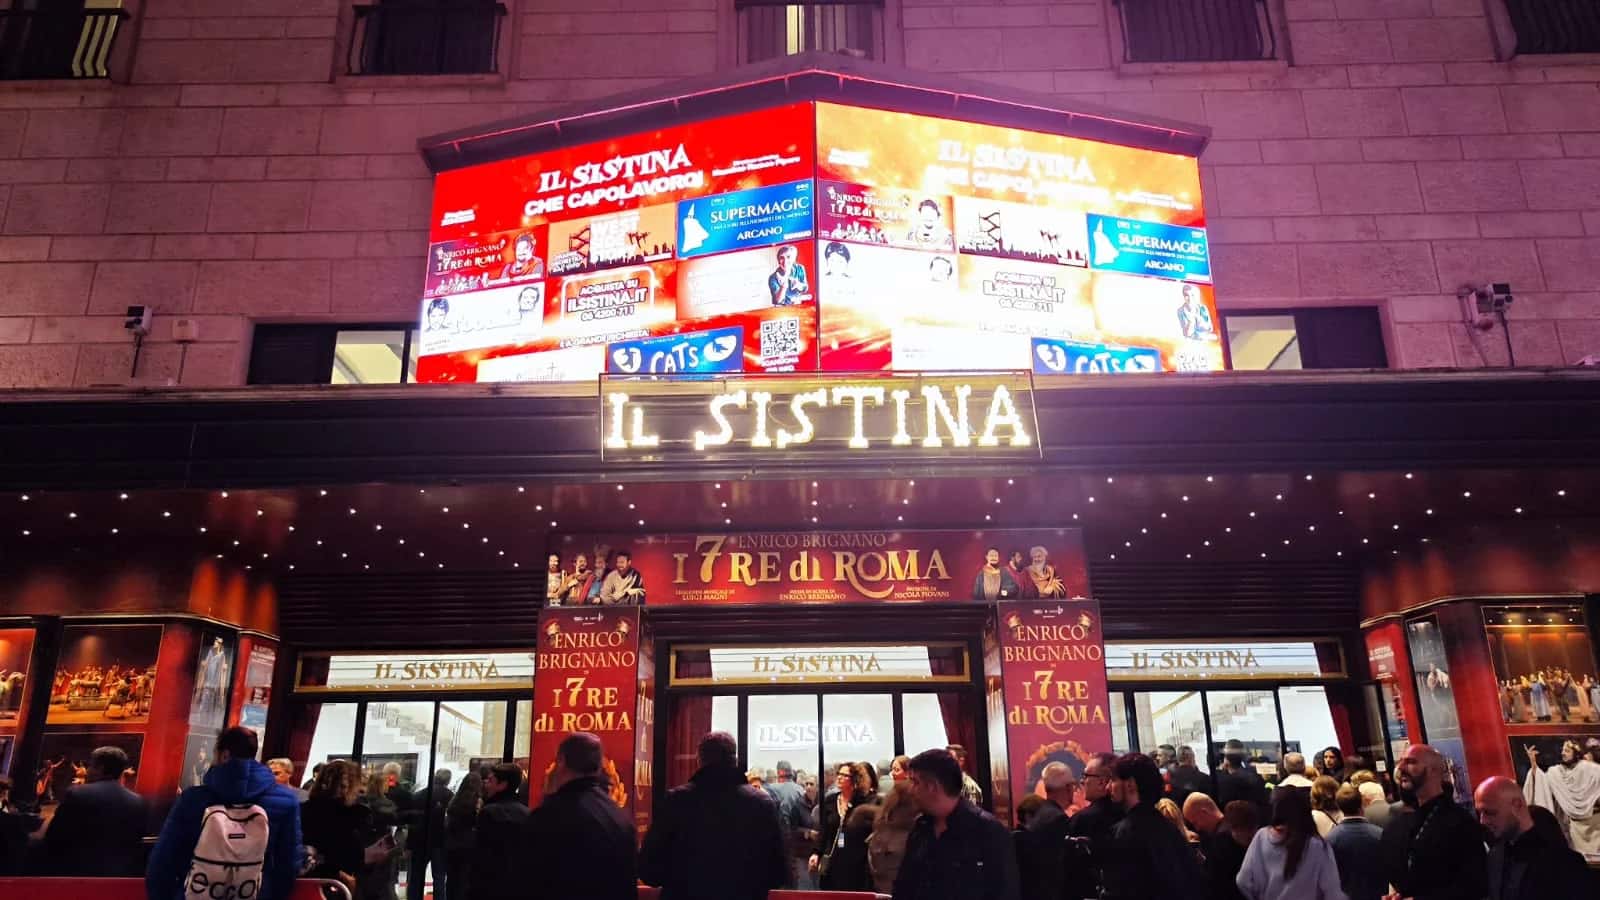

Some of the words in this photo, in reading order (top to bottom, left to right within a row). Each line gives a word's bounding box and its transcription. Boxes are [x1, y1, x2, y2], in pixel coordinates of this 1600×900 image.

[537, 170, 567, 193] IL
[570, 143, 692, 190] SISTINA
[525, 195, 564, 216] CHE
[710, 197, 809, 224] SUPERMAGIC
[737, 226, 783, 241] ARCANO
[1118, 233, 1205, 255] SUPERMAGIC
[451, 260, 464, 269] RE
[580, 281, 625, 295] ACQUISTA
[626, 279, 638, 289] SU
[567, 287, 648, 311] ILSISTINA.IT
[650, 342, 698, 373] CATS
[1076, 352, 1120, 374] CATS
[694, 385, 1031, 450] SISTINA
[739, 534, 798, 549] ENRICO
[802, 533, 886, 547] BRIGNANO
[672, 553, 688, 584] I
[695, 535, 727, 584] 7
[728, 551, 782, 587] RE
[789, 551, 824, 583] di
[833, 549, 952, 598] ROMA
[779, 593, 807, 601] ENRICO
[894, 591, 920, 599] NICOLA
[555, 632, 623, 649] ENRICO
[1017, 624, 1085, 642] ENRICO
[539, 651, 636, 669] BRIGNANO
[751, 656, 777, 673] IL
[780, 652, 881, 674] SISTINA
[1004, 645, 1102, 662] BRIGNANO
[1131, 652, 1155, 670] IL
[1160, 648, 1261, 671] SISTINA
[375, 663, 397, 680] IL
[401, 658, 500, 681] SISTINA
[552, 689, 563, 708] I
[566, 677, 587, 707] 7
[586, 687, 619, 708] RE
[1022, 681, 1033, 701] I
[1034, 670, 1055, 700] 7
[1056, 680, 1089, 701] RE
[535, 713, 555, 732] di
[562, 711, 633, 732] ROMA
[1008, 705, 1030, 725] di
[1035, 704, 1107, 734] ROMA
[760, 726, 780, 742] IL
[783, 725, 873, 743] SISTINA
